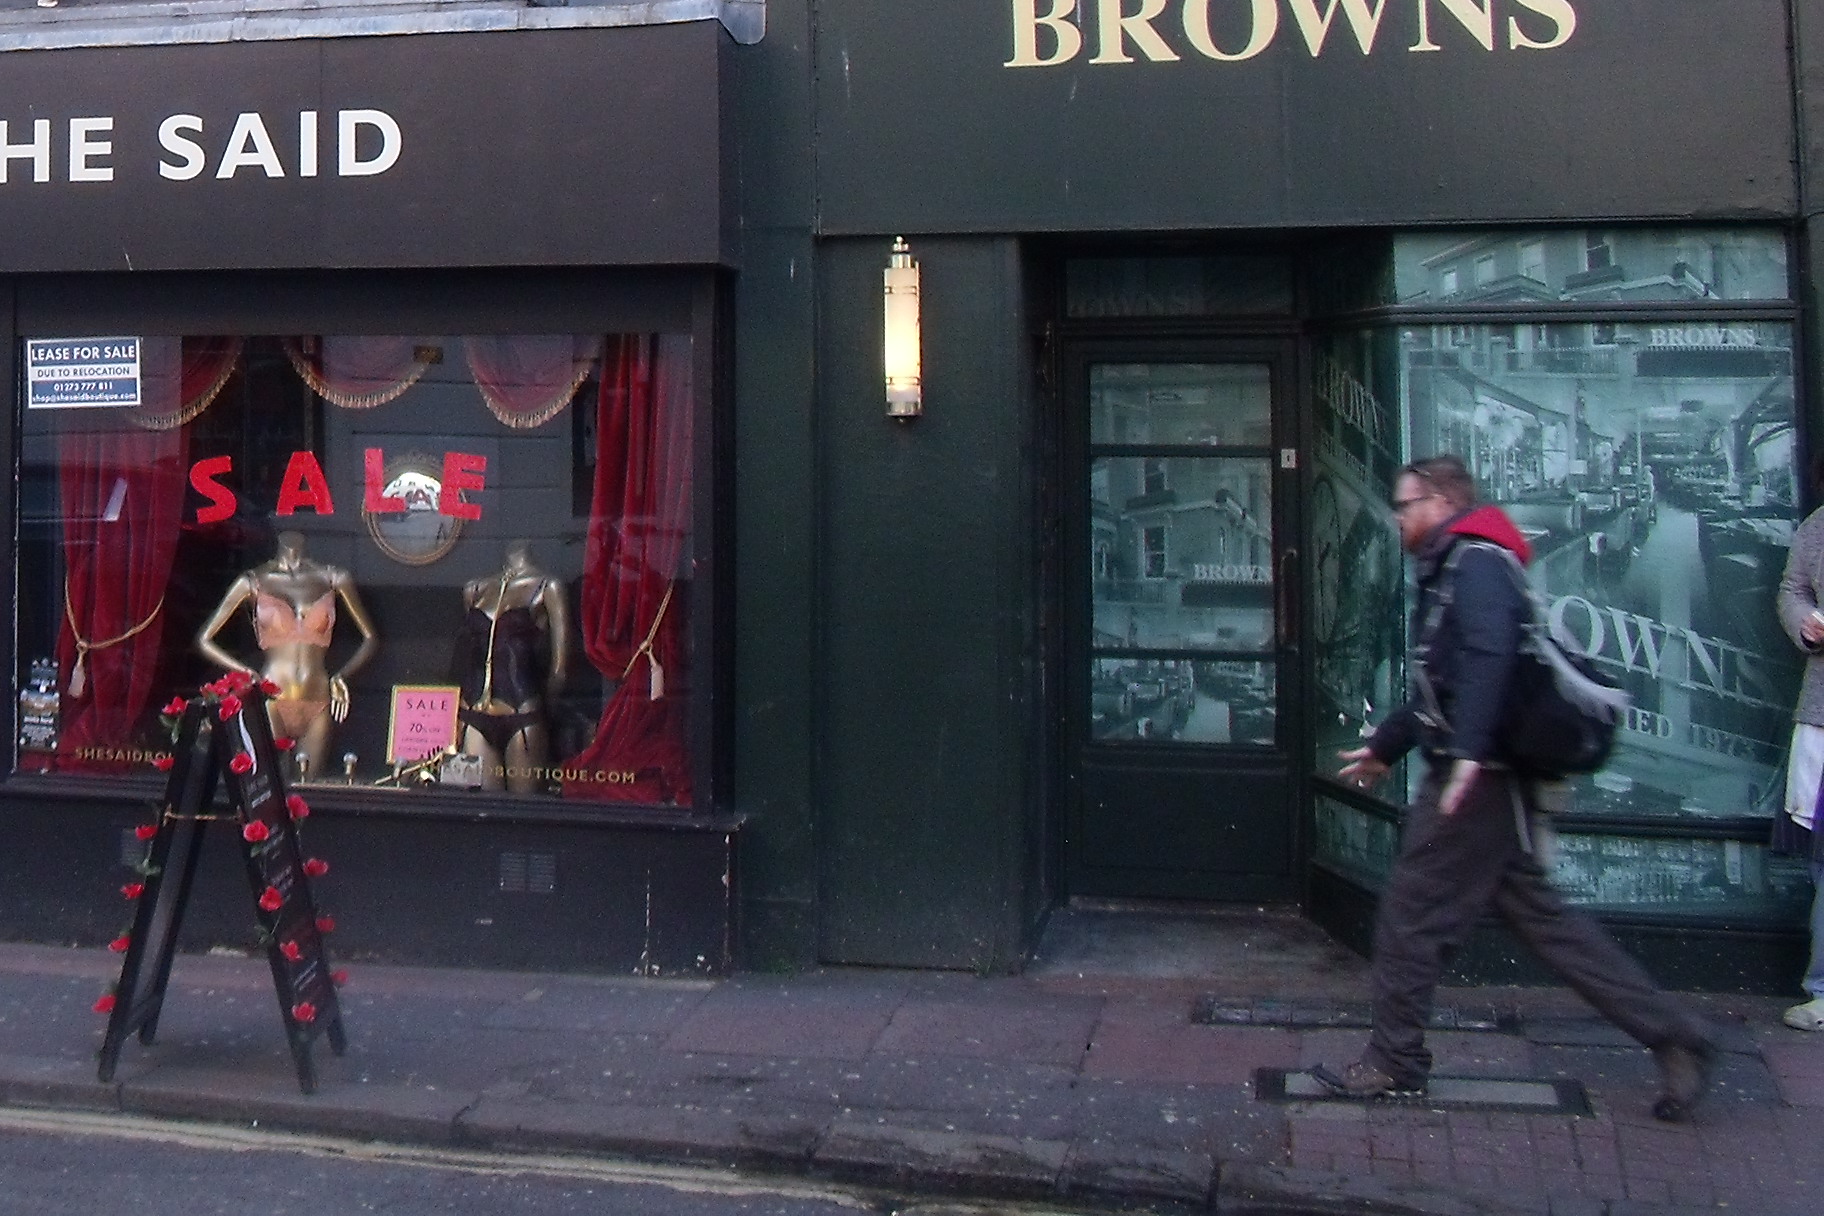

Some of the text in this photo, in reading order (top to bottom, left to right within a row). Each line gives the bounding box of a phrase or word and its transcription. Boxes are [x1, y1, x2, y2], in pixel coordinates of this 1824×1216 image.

[157, 109, 403, 181] SAID
[1650, 328, 1755, 346] BROWNS
[31, 345, 135, 361] LEASE FOR SALE
[37, 367, 130, 378] DUE TO RELOCATION
[81, 382, 96, 391] 777
[189, 448, 487, 524] SALE
[1548, 595, 1773, 708] OWNS
[406, 699, 448, 711] SALE
